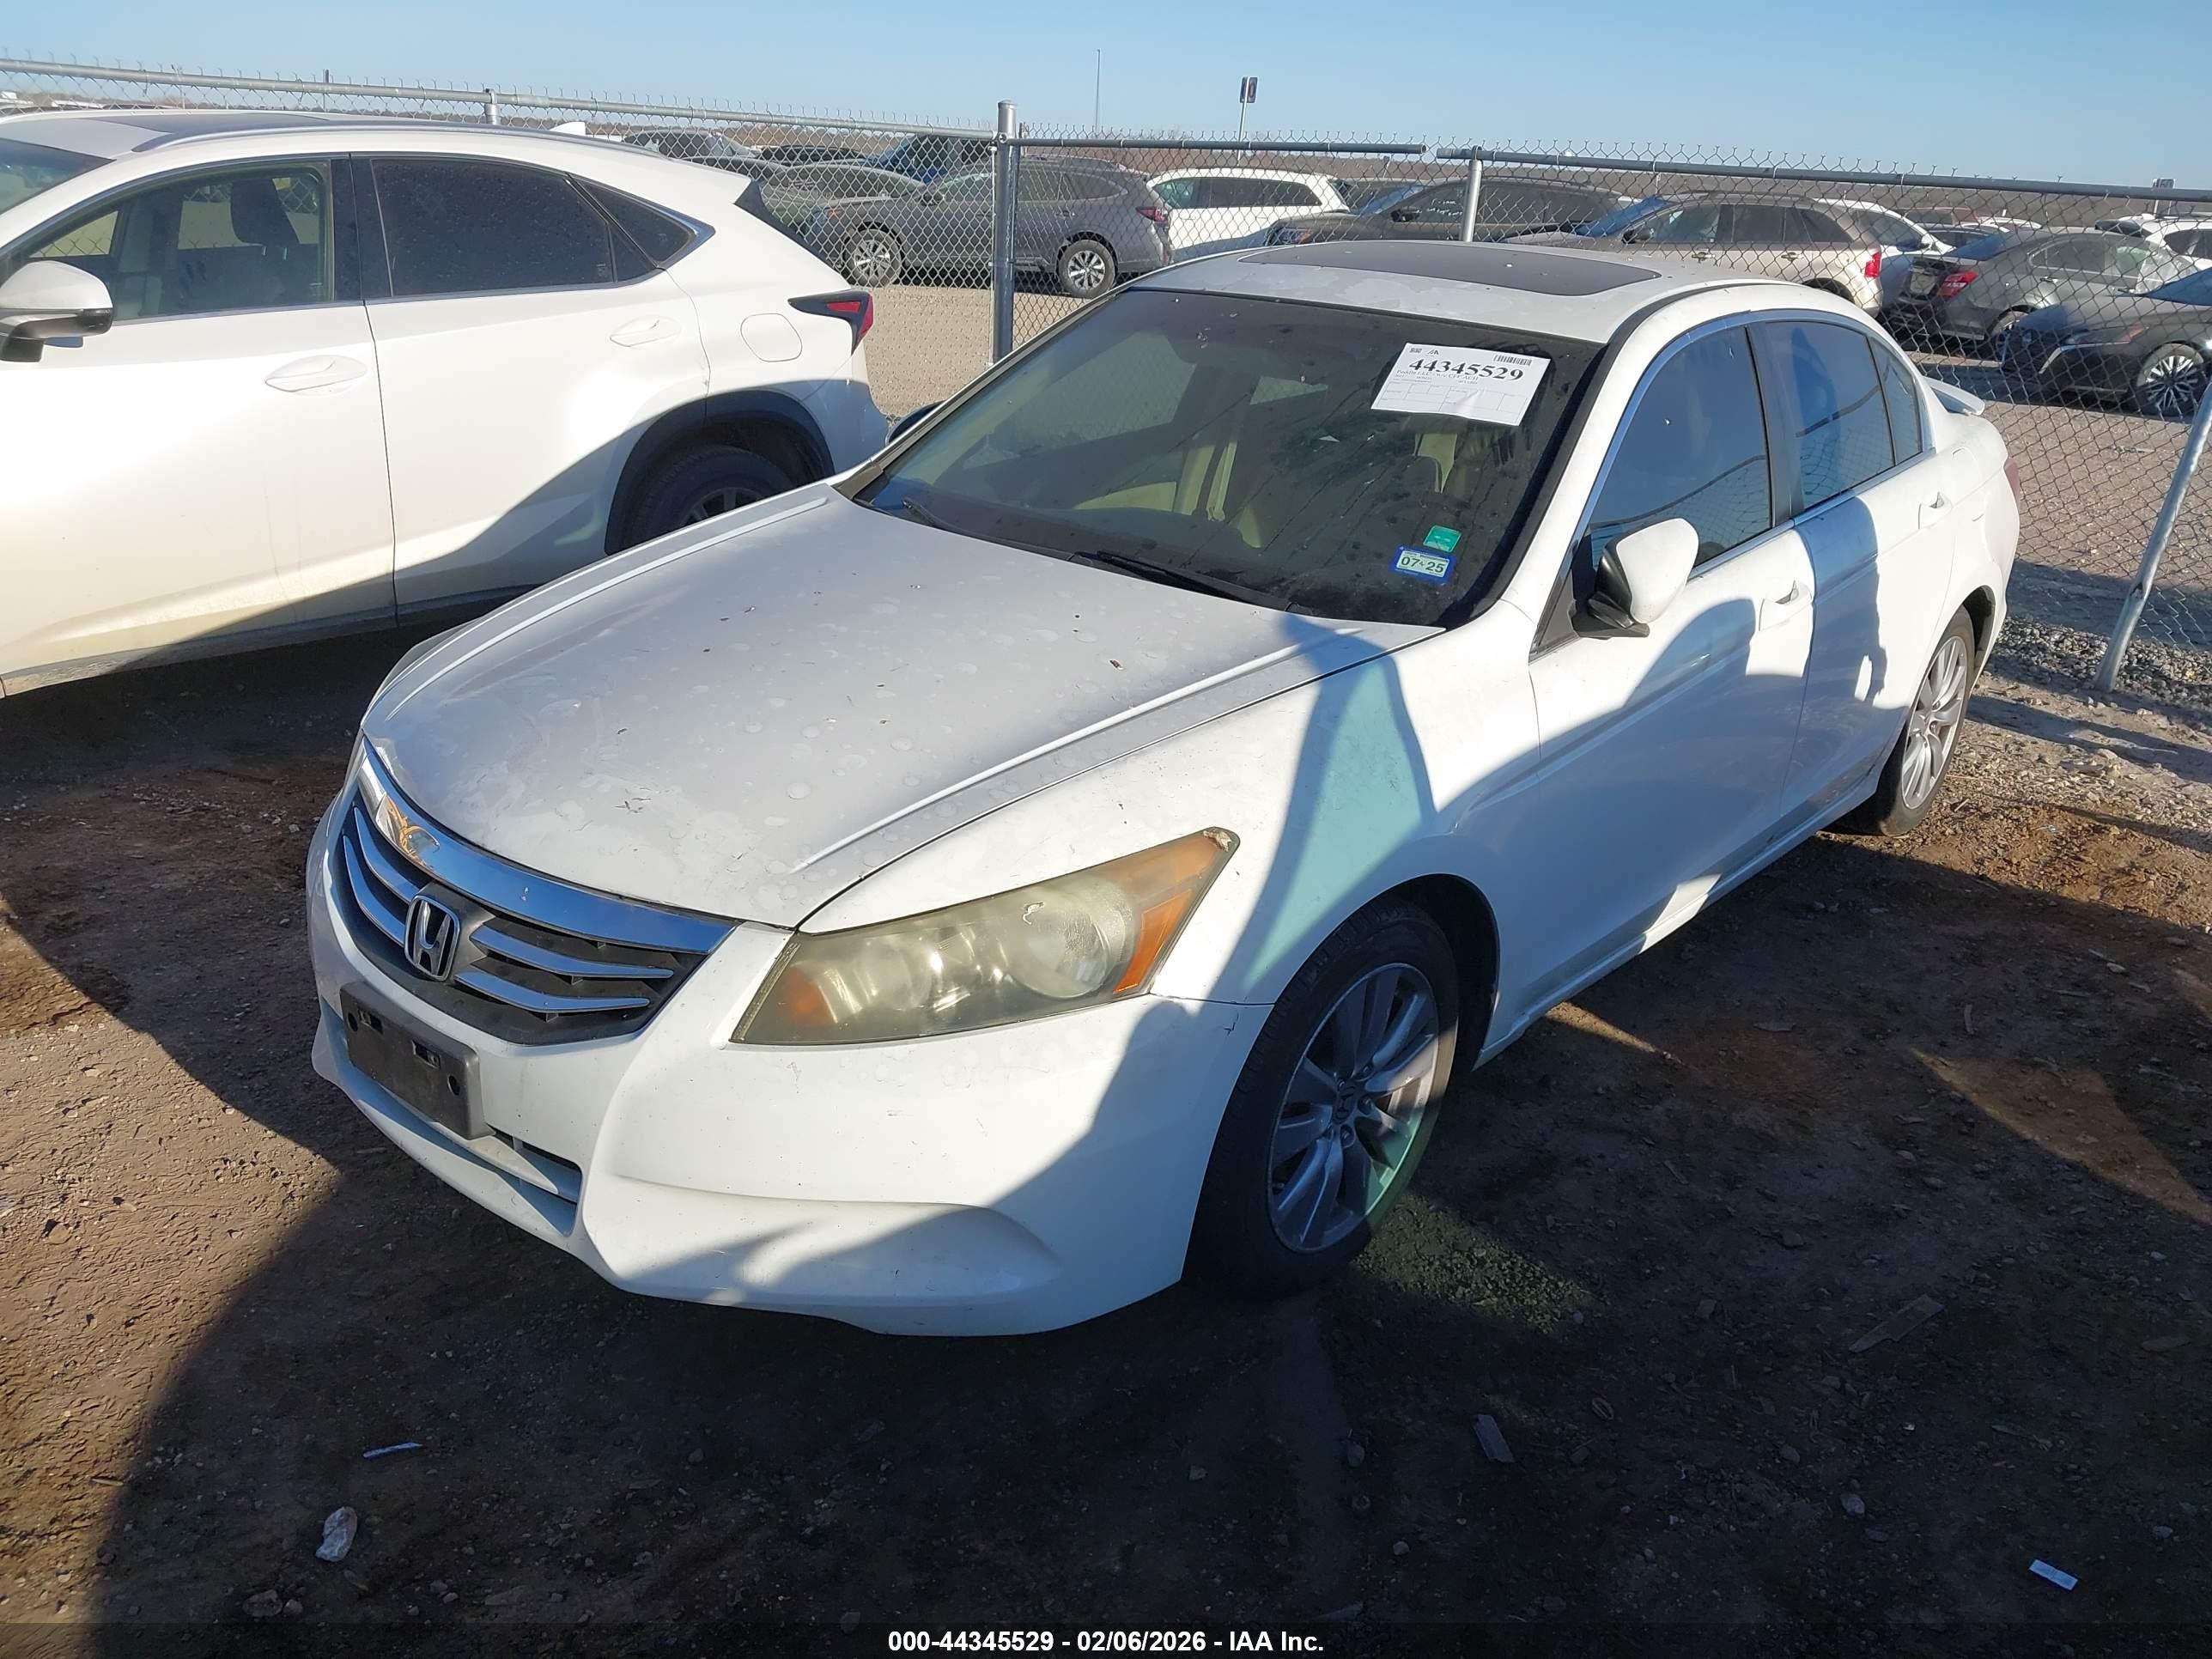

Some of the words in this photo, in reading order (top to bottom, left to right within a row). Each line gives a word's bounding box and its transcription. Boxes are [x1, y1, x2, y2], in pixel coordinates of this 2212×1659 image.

[1409, 359, 1524, 380] 44345529
[1401, 556, 1419, 567] 07
[1425, 562, 1445, 573] 25
